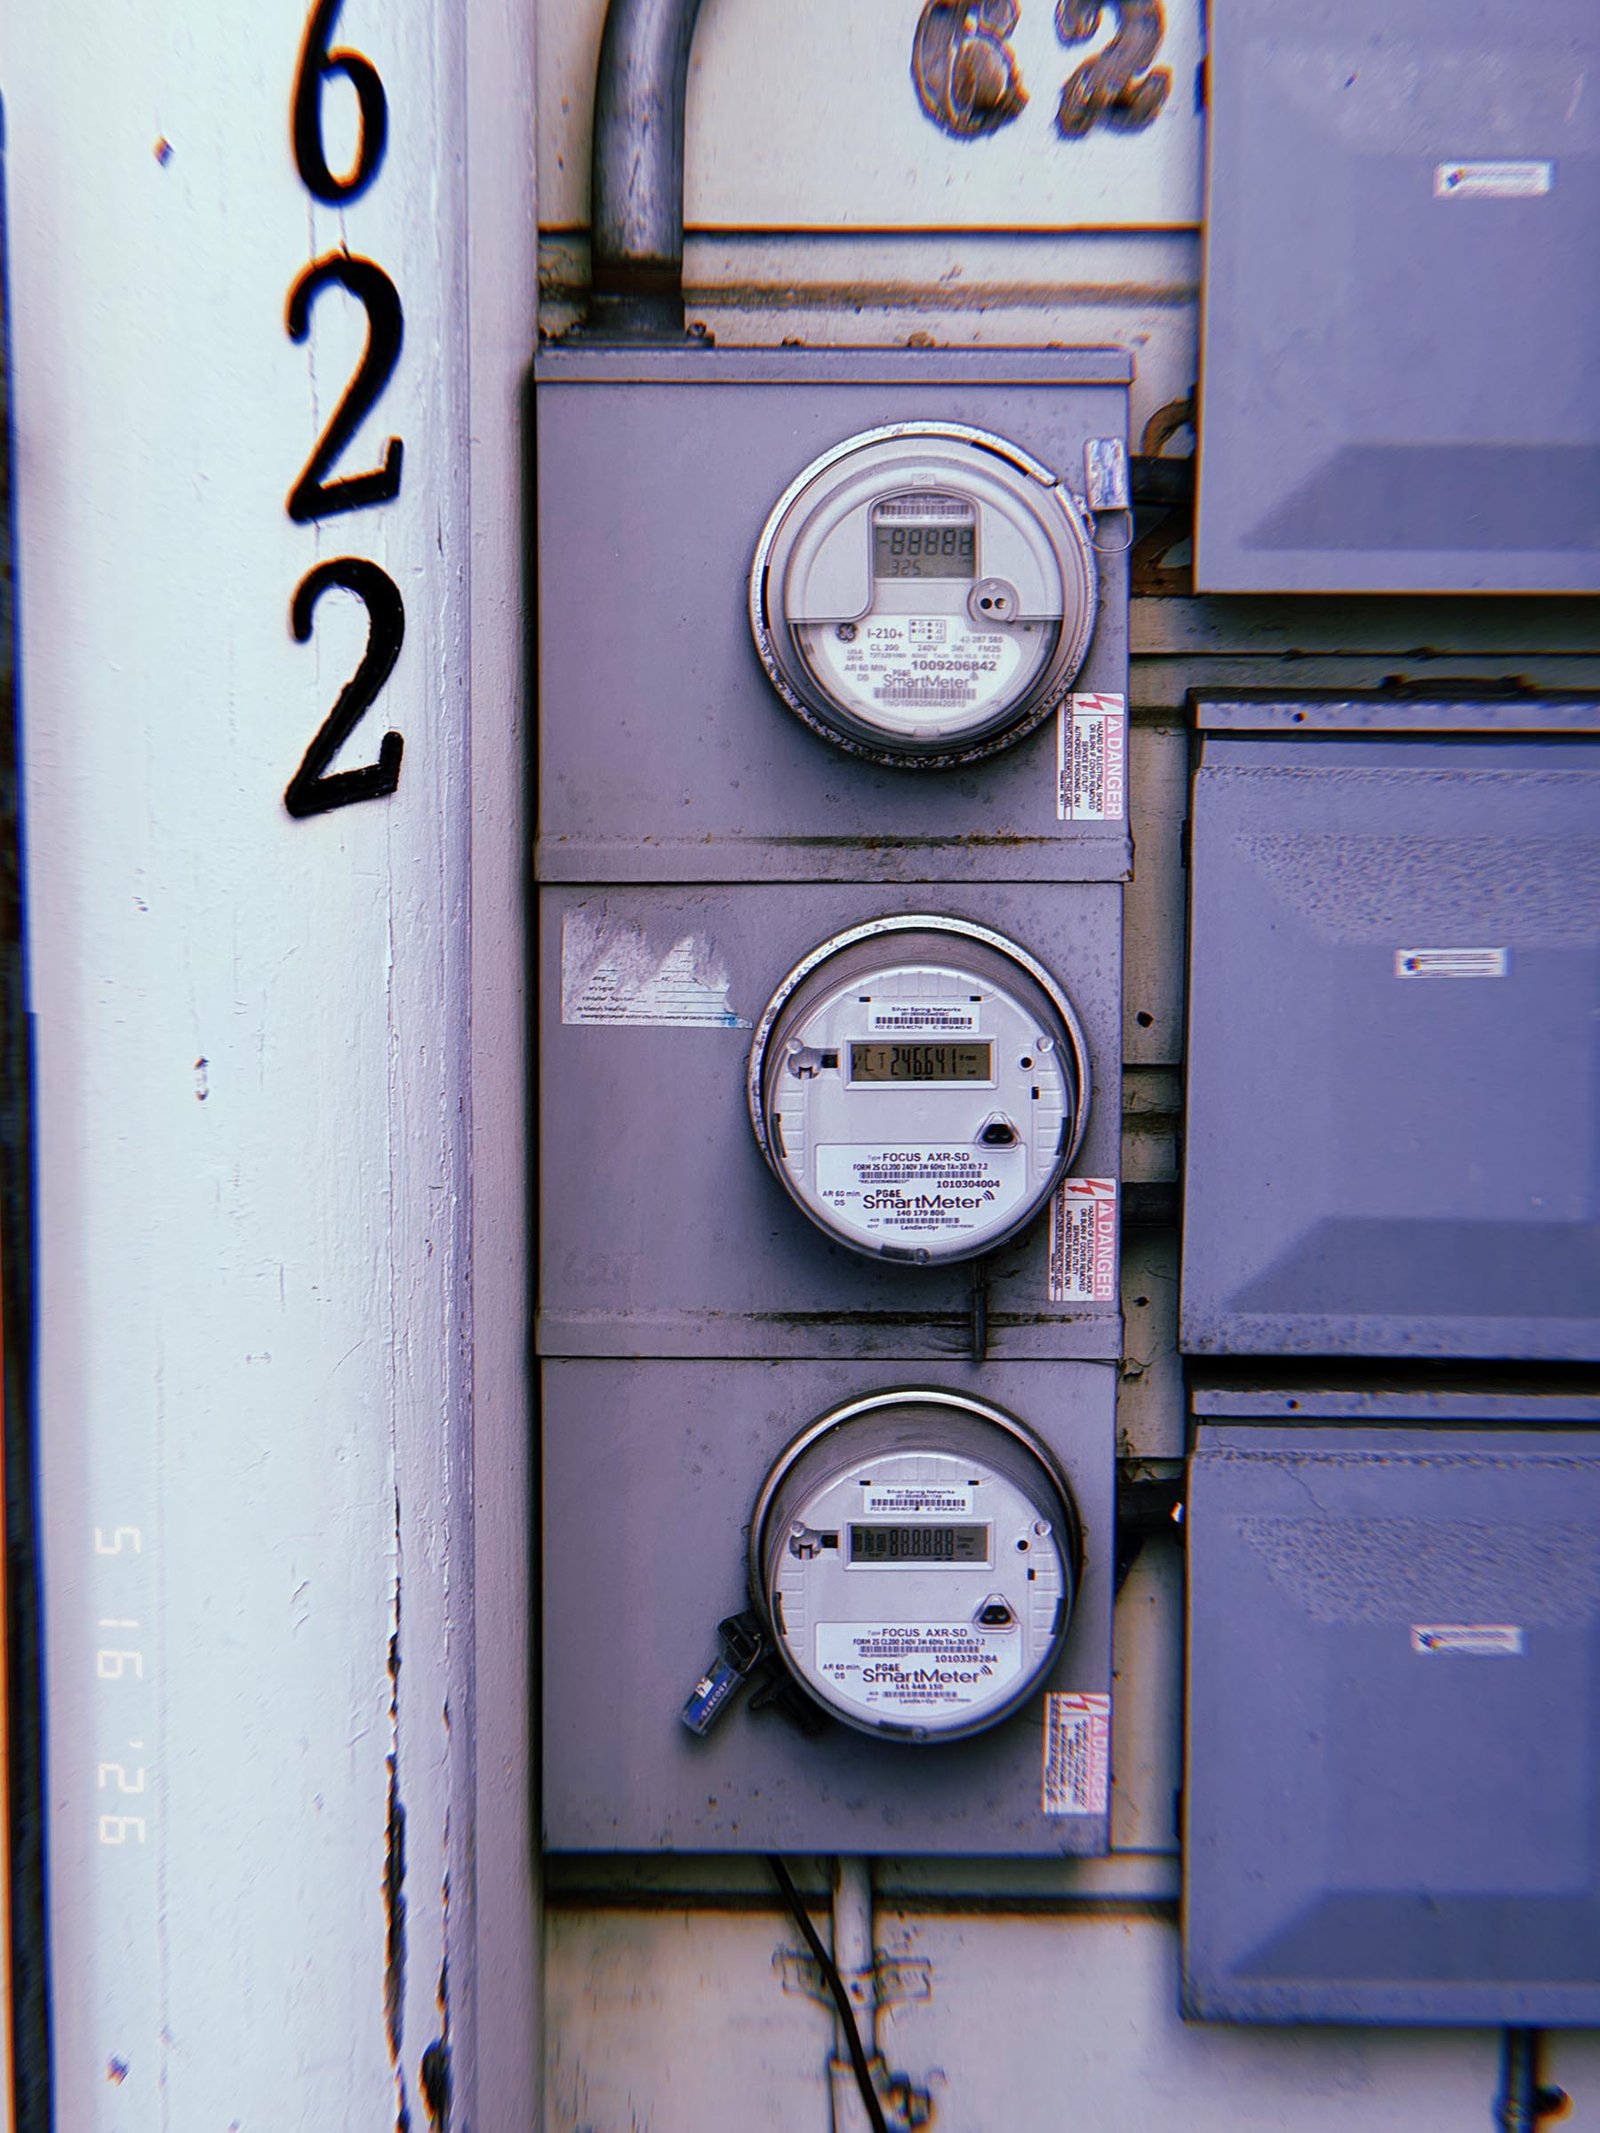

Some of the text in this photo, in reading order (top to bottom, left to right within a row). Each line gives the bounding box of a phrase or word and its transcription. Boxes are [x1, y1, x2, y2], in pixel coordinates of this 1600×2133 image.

[867, 628, 904, 639] I-210+
[911, 661, 998, 672] 1009206842
[883, 674, 970, 688] SmartMeter
[1088, 724, 1096, 733] OR
[1096, 746, 1103, 754] OF
[1088, 759, 1096, 779] COVER
[1107, 737, 1123, 814] DANGER
[1088, 780, 1096, 810] REMOVED
[882, 1153, 922, 1162] FOCUS
[927, 1153, 970, 1162] AXR-SD
[853, 1163, 871, 1171] FORM
[902, 1163, 918, 1171] 240V
[936, 1180, 1001, 1188] 1010304004
[875, 1189, 902, 1198] PG&E
[863, 1194, 983, 1209] SmartMeter
[1097, 1221, 1113, 1296] DANGER
[882, 1629, 920, 1637] FOCUS
[926, 1629, 968, 1637] AXR-SD
[934, 1655, 998, 1663] 1010339284
[875, 1664, 901, 1672] PG&E
[862, 1668, 980, 1683] SmartMeter
